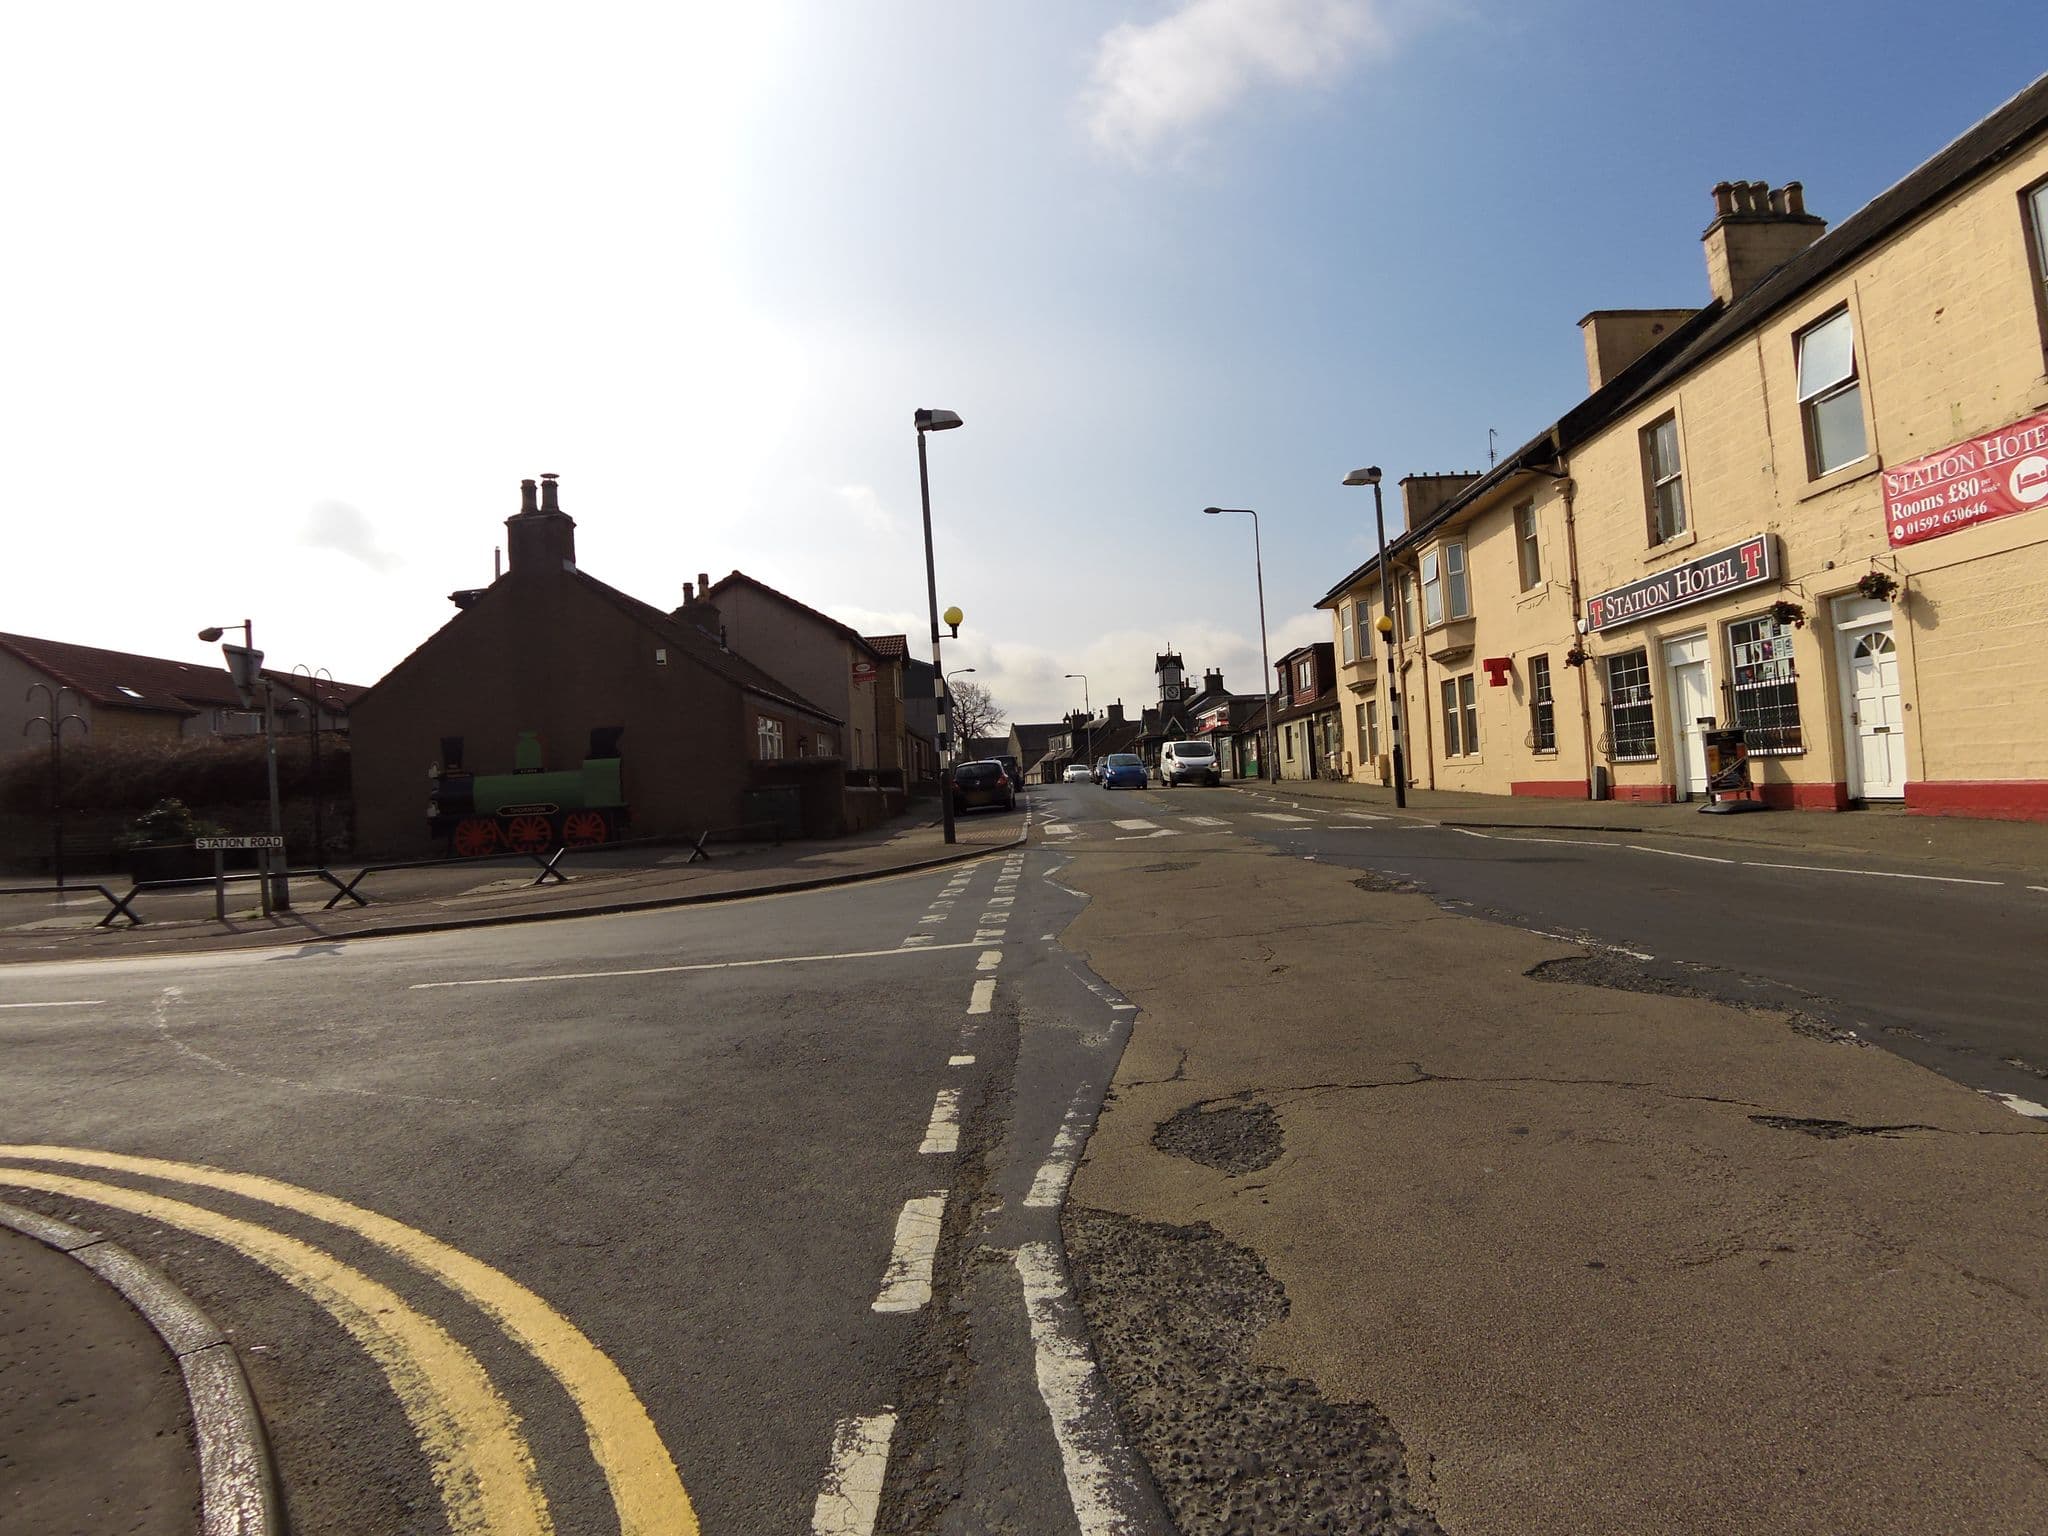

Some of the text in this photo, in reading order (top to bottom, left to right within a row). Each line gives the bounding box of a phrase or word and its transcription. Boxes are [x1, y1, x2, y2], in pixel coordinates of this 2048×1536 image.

[1887, 423, 2048, 497] STATION HOTE
[1891, 478, 1979, 522] Rooms £80
[1907, 501, 1988, 535] 01592 630646
[1590, 542, 1762, 627] T STATION HOTEL T
[197, 837, 281, 848] STATION ROAD
